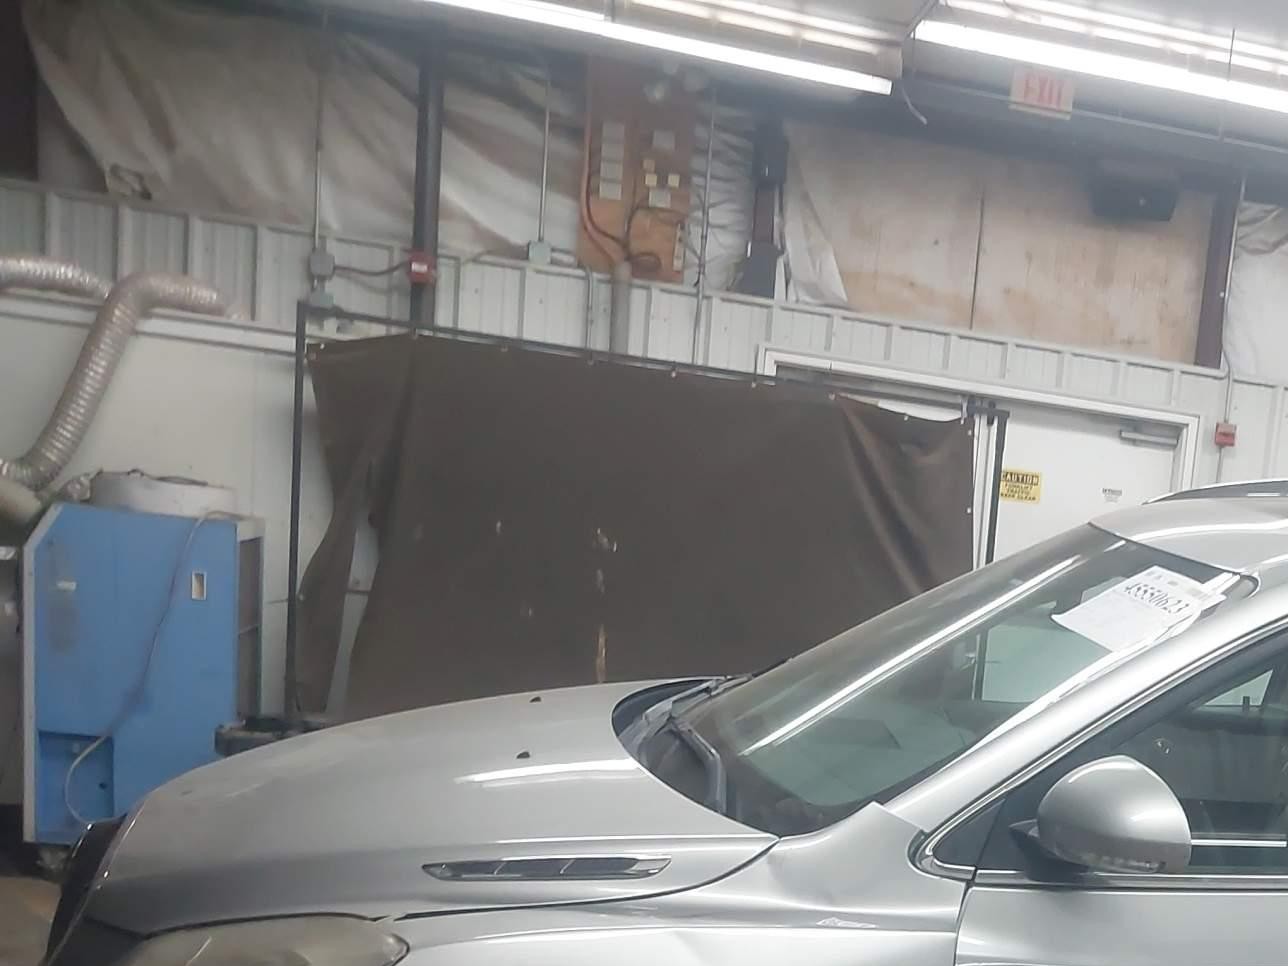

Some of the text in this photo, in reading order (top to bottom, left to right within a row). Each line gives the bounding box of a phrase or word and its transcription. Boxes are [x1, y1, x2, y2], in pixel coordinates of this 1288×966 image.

[1023, 71, 1065, 109] EXIT
[1001, 471, 1039, 485] CAUTION
[1126, 583, 1190, 614] 45550623
